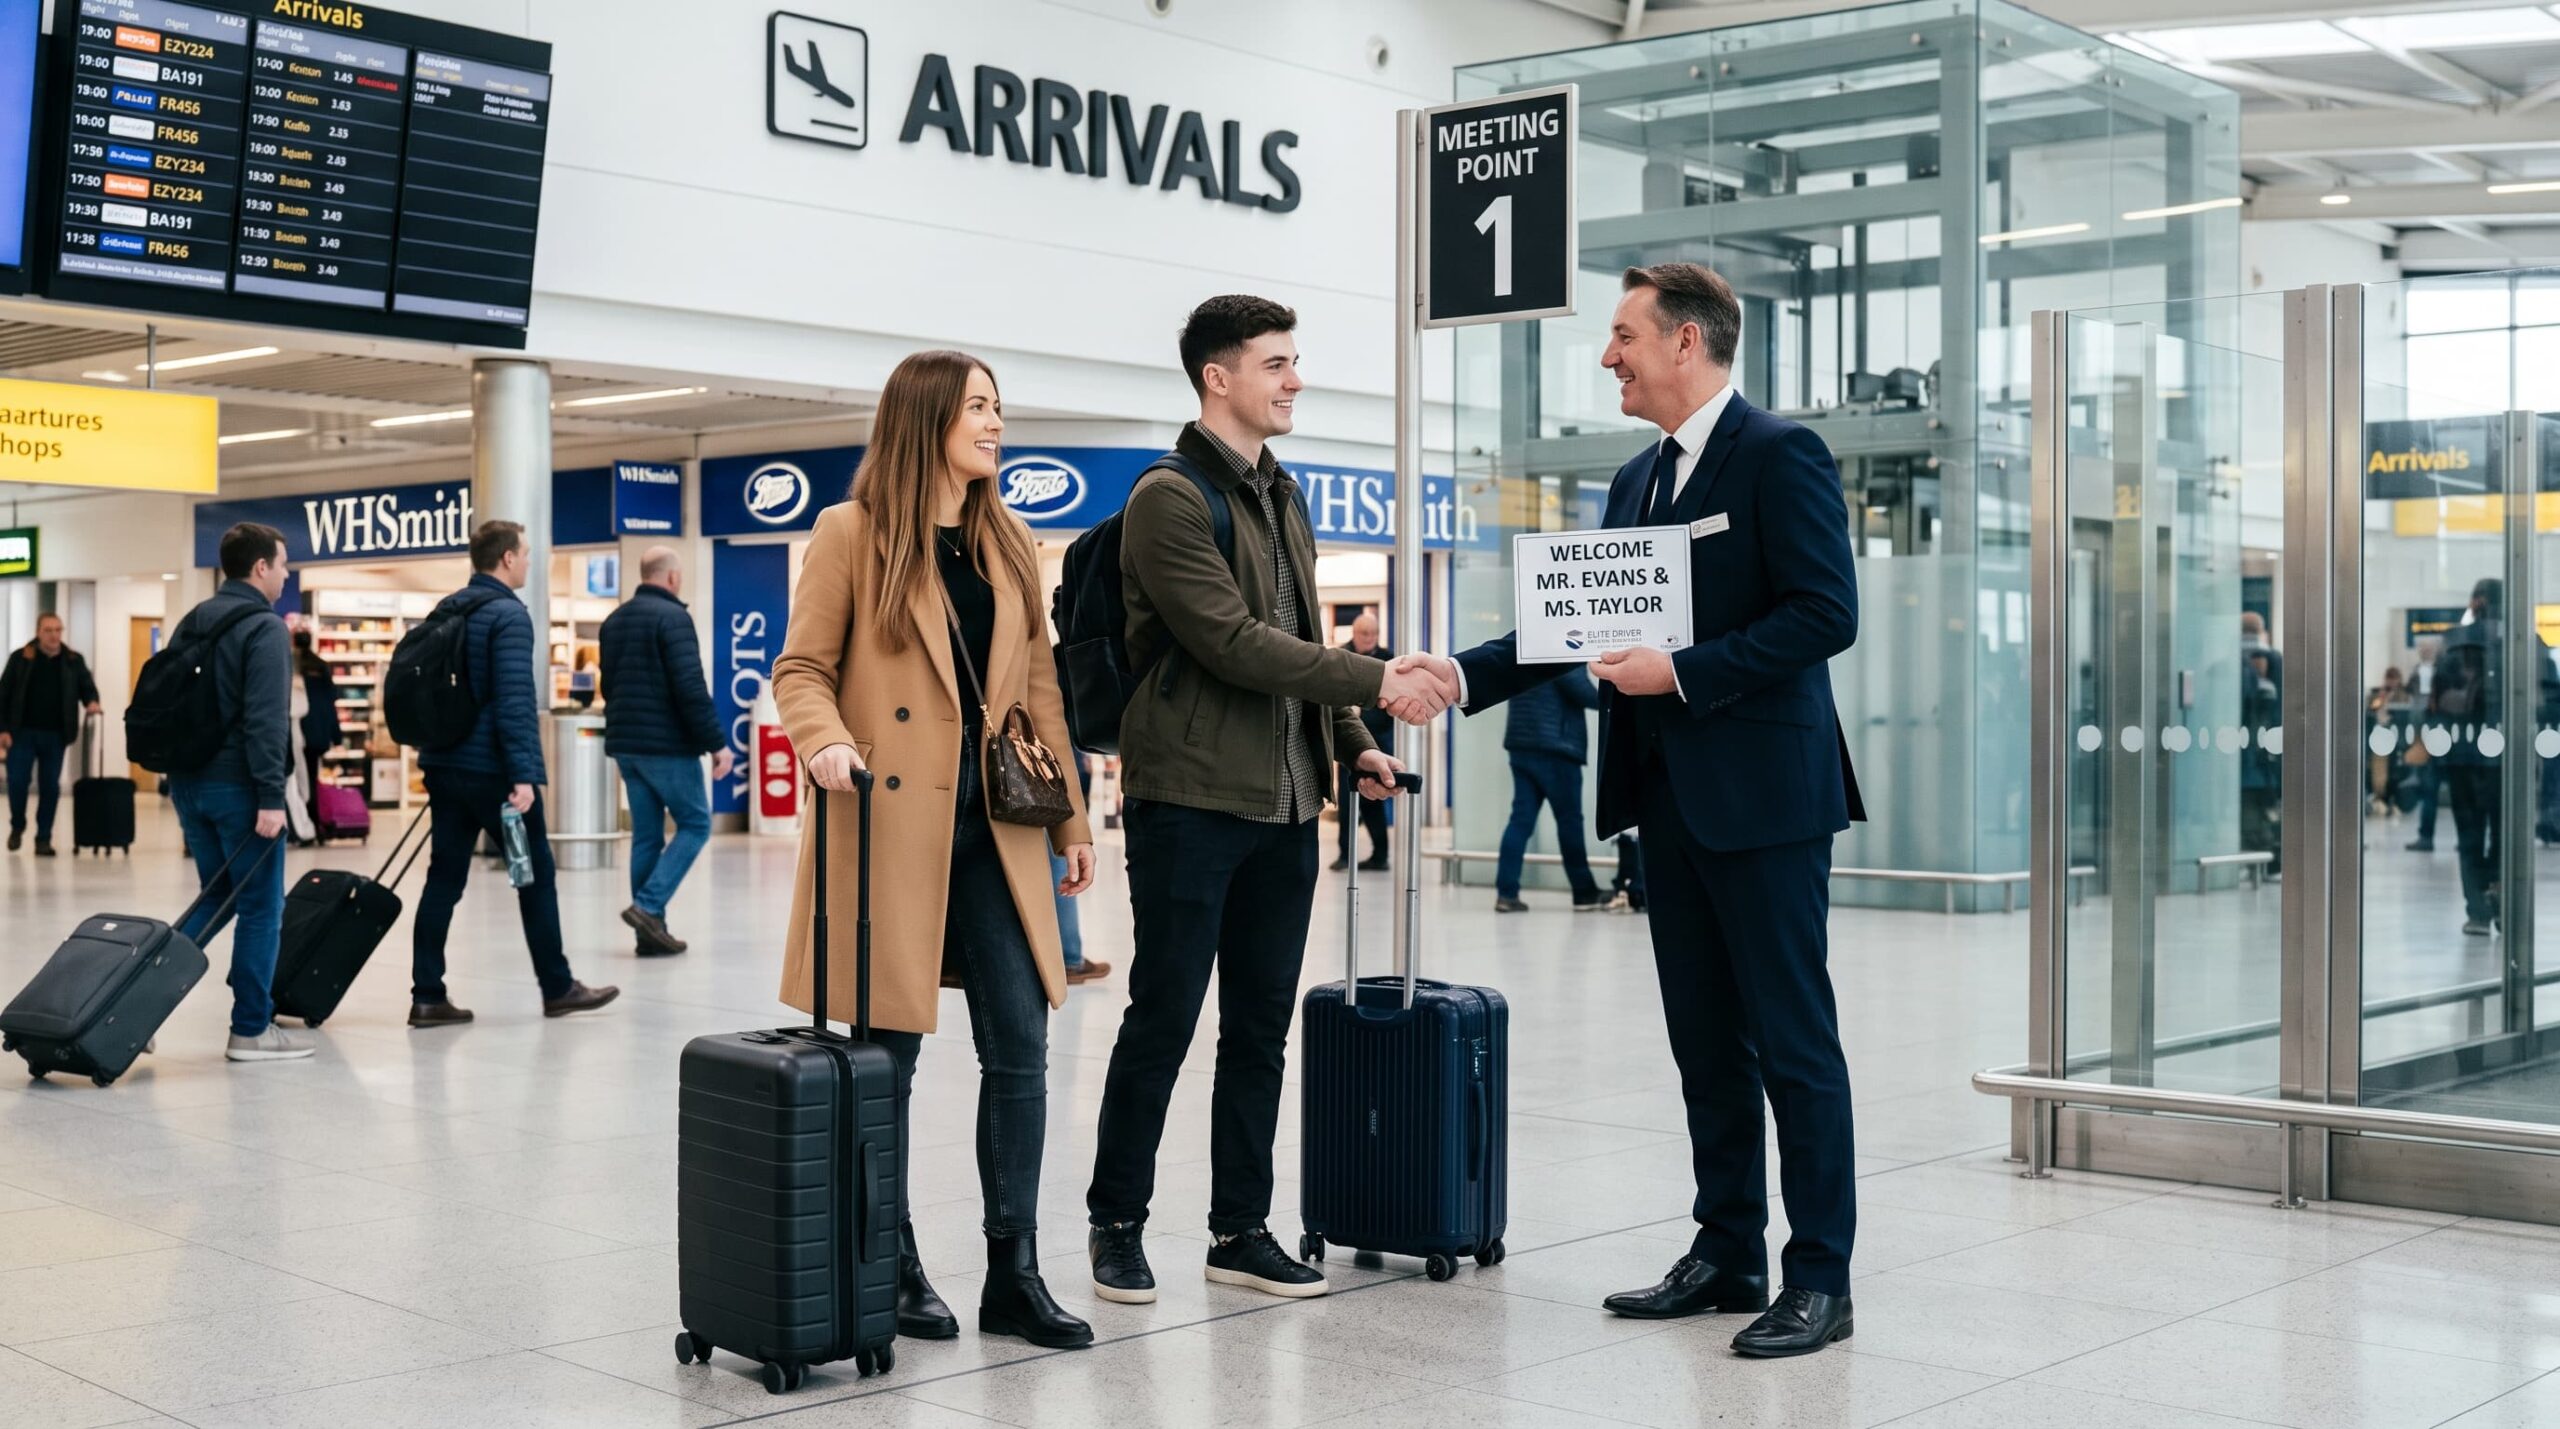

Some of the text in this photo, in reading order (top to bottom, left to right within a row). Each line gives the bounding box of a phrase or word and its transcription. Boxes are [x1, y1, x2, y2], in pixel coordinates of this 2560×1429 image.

[274, 0, 364, 29] Arrivals
[165, 38, 214, 59] EZY224
[161, 67, 203, 86] BA191
[159, 96, 201, 115] FR456
[157, 125, 199, 144] FR456
[899, 54, 1300, 213] ARRIVALS
[1438, 108, 1559, 152] MEETING
[155, 154, 205, 174] EZY234
[1457, 147, 1539, 184] POINT
[153, 183, 203, 202] EZY234
[149, 212, 192, 230] BA191
[148, 241, 189, 258] FR456
[1475, 196, 1511, 296] 1
[0, 433, 62, 462] hops
[2368, 447, 2470, 474] Arrivals
[304, 488, 474, 555] WHSmith
[1551, 541, 1652, 561] WELCOME
[1538, 567, 1669, 589] MR. EVANS &
[1546, 596, 1662, 617] MS. TAYLOR
[1588, 629, 1642, 639] ELITE DRIVER
